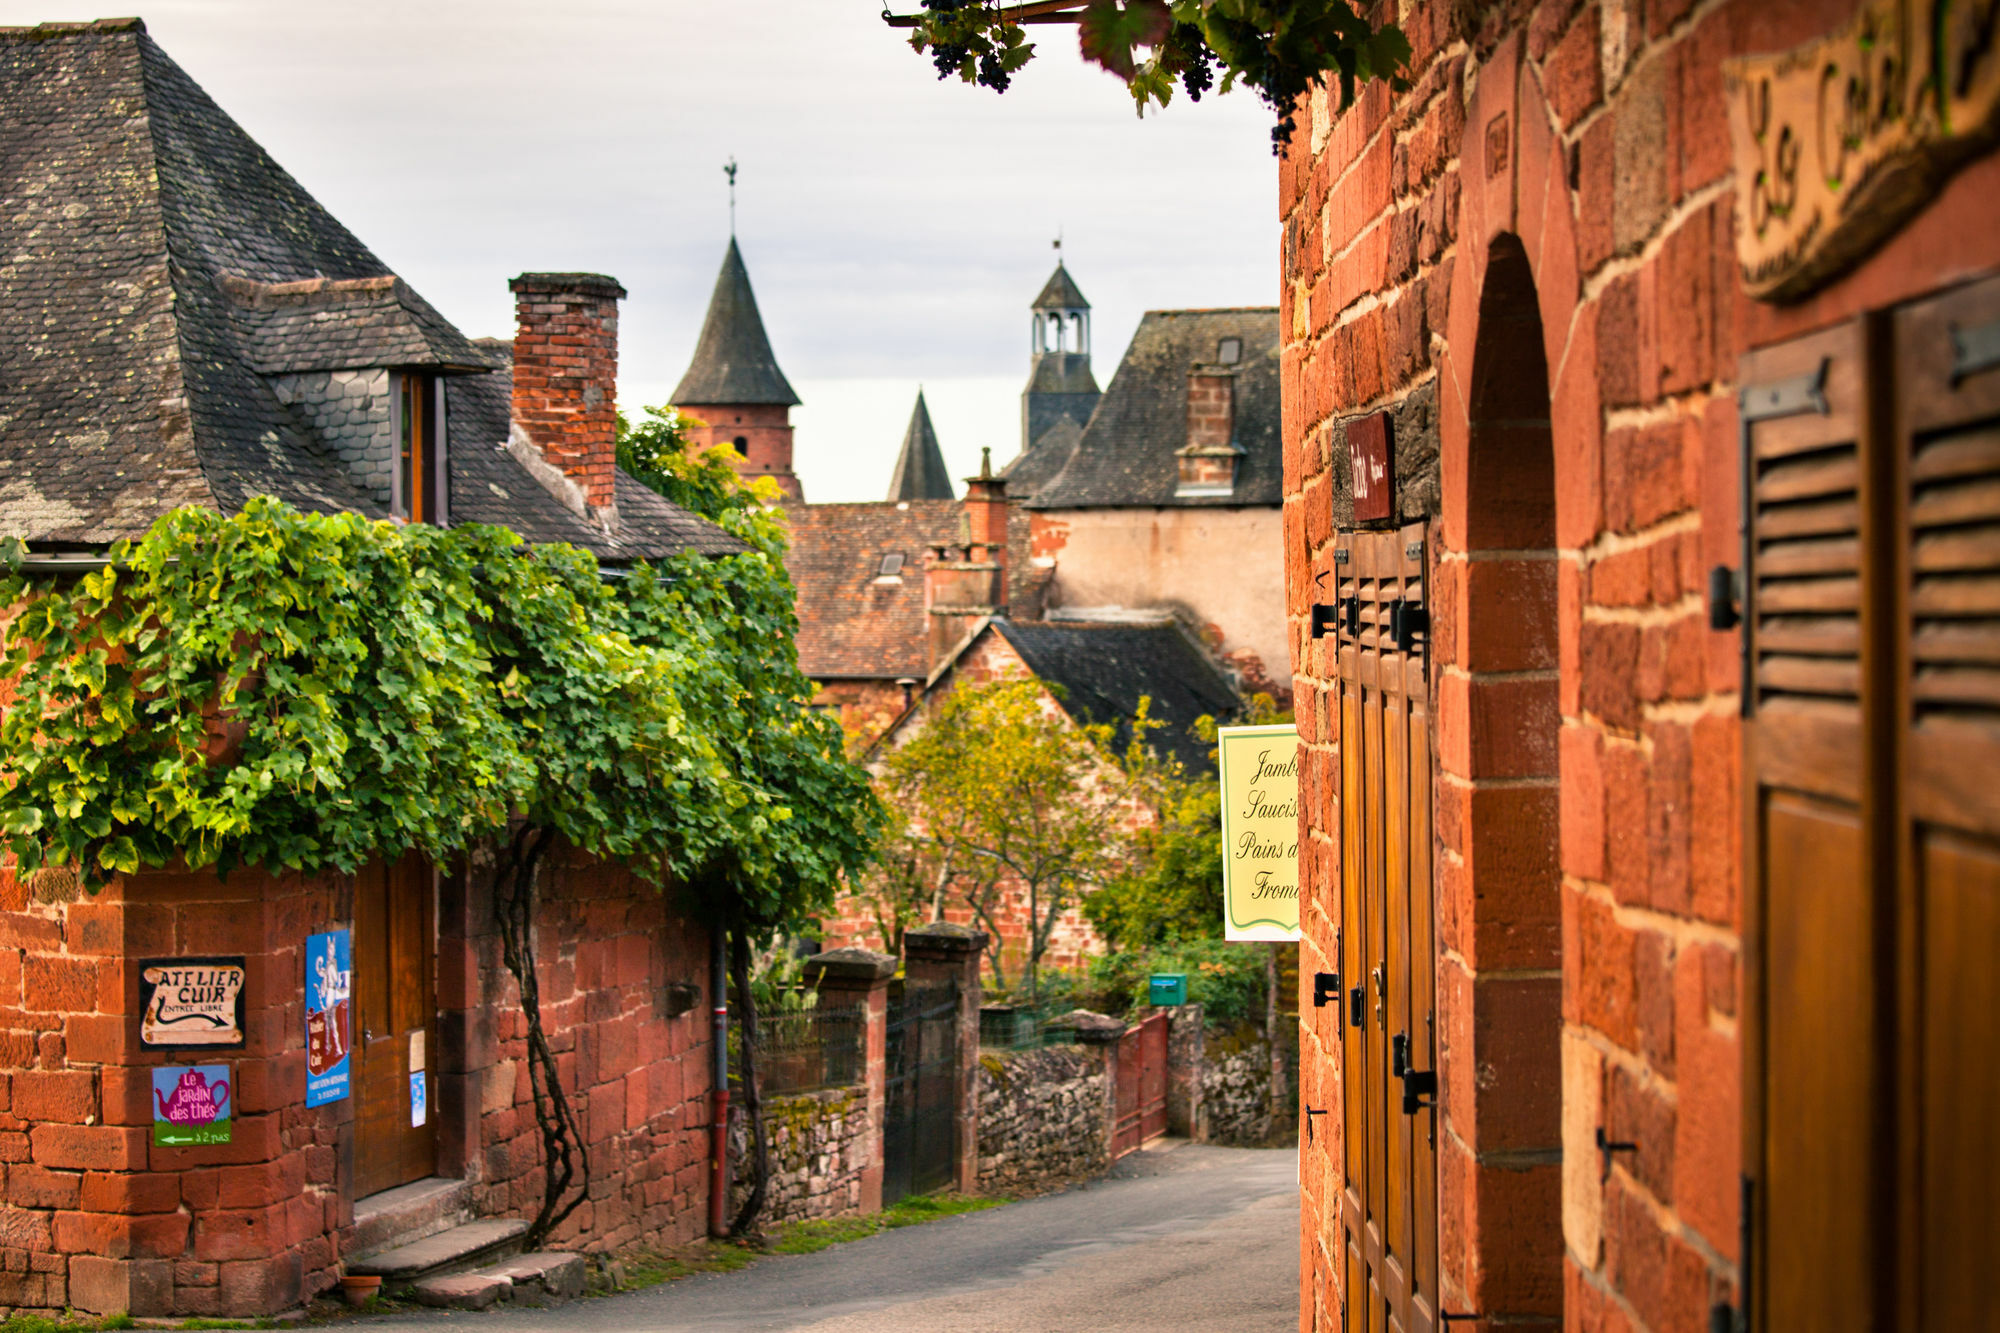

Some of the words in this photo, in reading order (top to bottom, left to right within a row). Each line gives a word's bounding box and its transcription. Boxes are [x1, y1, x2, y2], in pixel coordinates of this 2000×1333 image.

[1243, 790, 1299, 819] Saucis
[1236, 831, 1284, 859] Pains
[158, 970, 240, 987] ATELIER
[178, 986, 226, 1004] CUIR
[200, 1004, 223, 1012] LIBRE
[170, 1104, 189, 1121] des
[190, 1102, 216, 1119] thés
[202, 1131, 210, 1143] 2
[211, 1133, 230, 1144] pas
